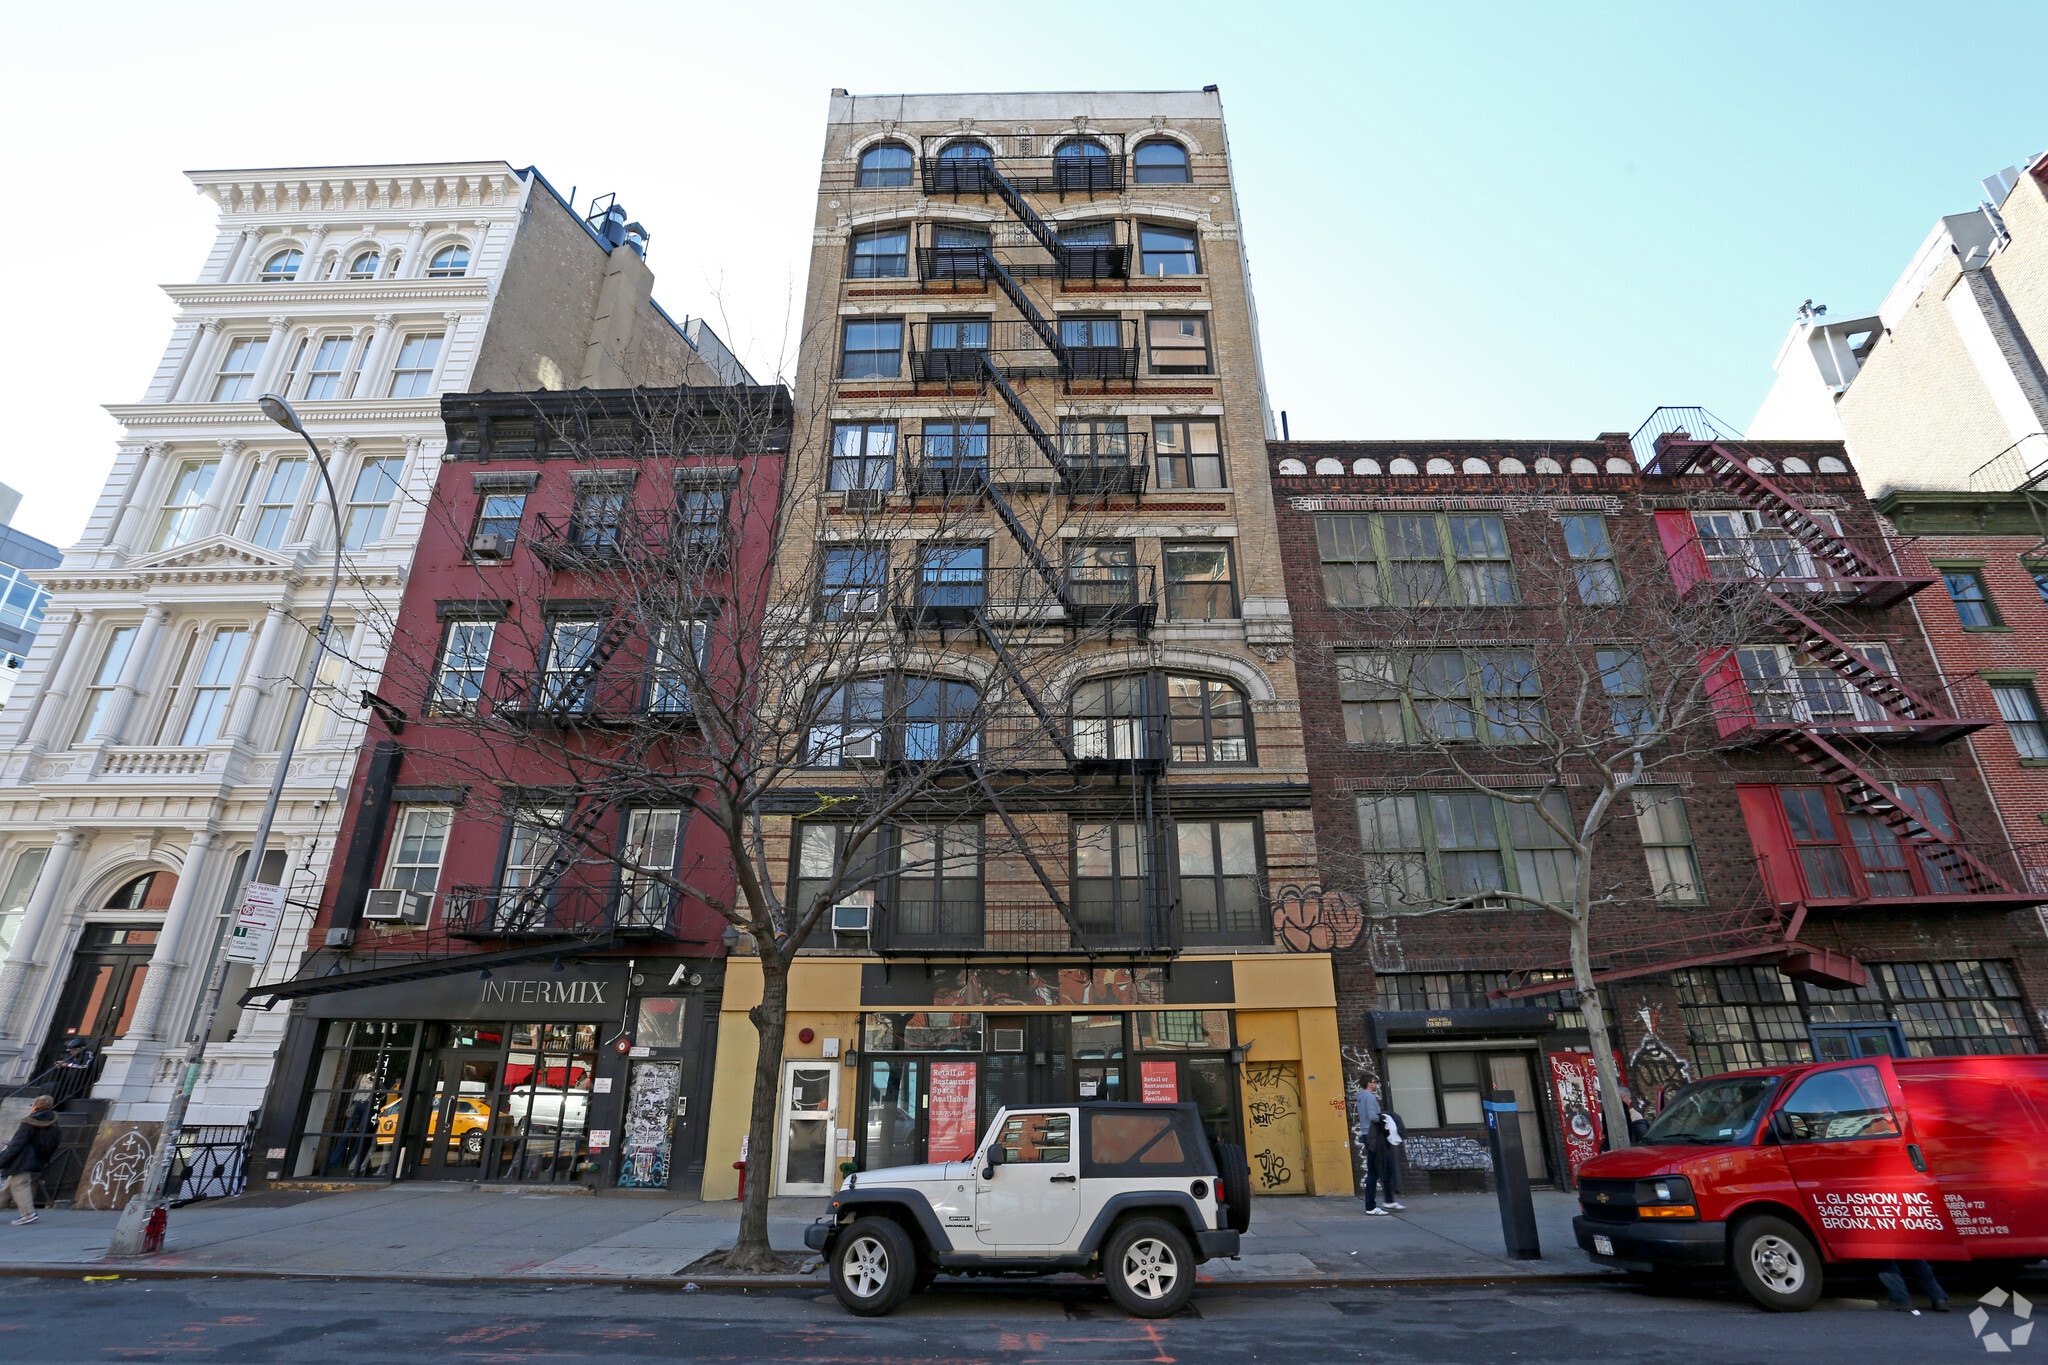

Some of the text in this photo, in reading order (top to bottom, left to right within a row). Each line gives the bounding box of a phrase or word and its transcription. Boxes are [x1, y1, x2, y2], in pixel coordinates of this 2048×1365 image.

[258, 885, 278, 893] PARKING
[481, 980, 608, 1004] INTERMIX
[932, 1086, 955, 1094] Space
[932, 1095, 968, 1103] Available
[1813, 1193, 1934, 1205] L. GLASHOW, INC.
[1818, 1205, 1939, 1217] 3462 BAILEY AVE.
[1949, 1209, 1970, 1217] RRA
[1821, 1217, 1944, 1230] BRONX, NY 10463
[1978, 1226, 1990, 1235] LIC
